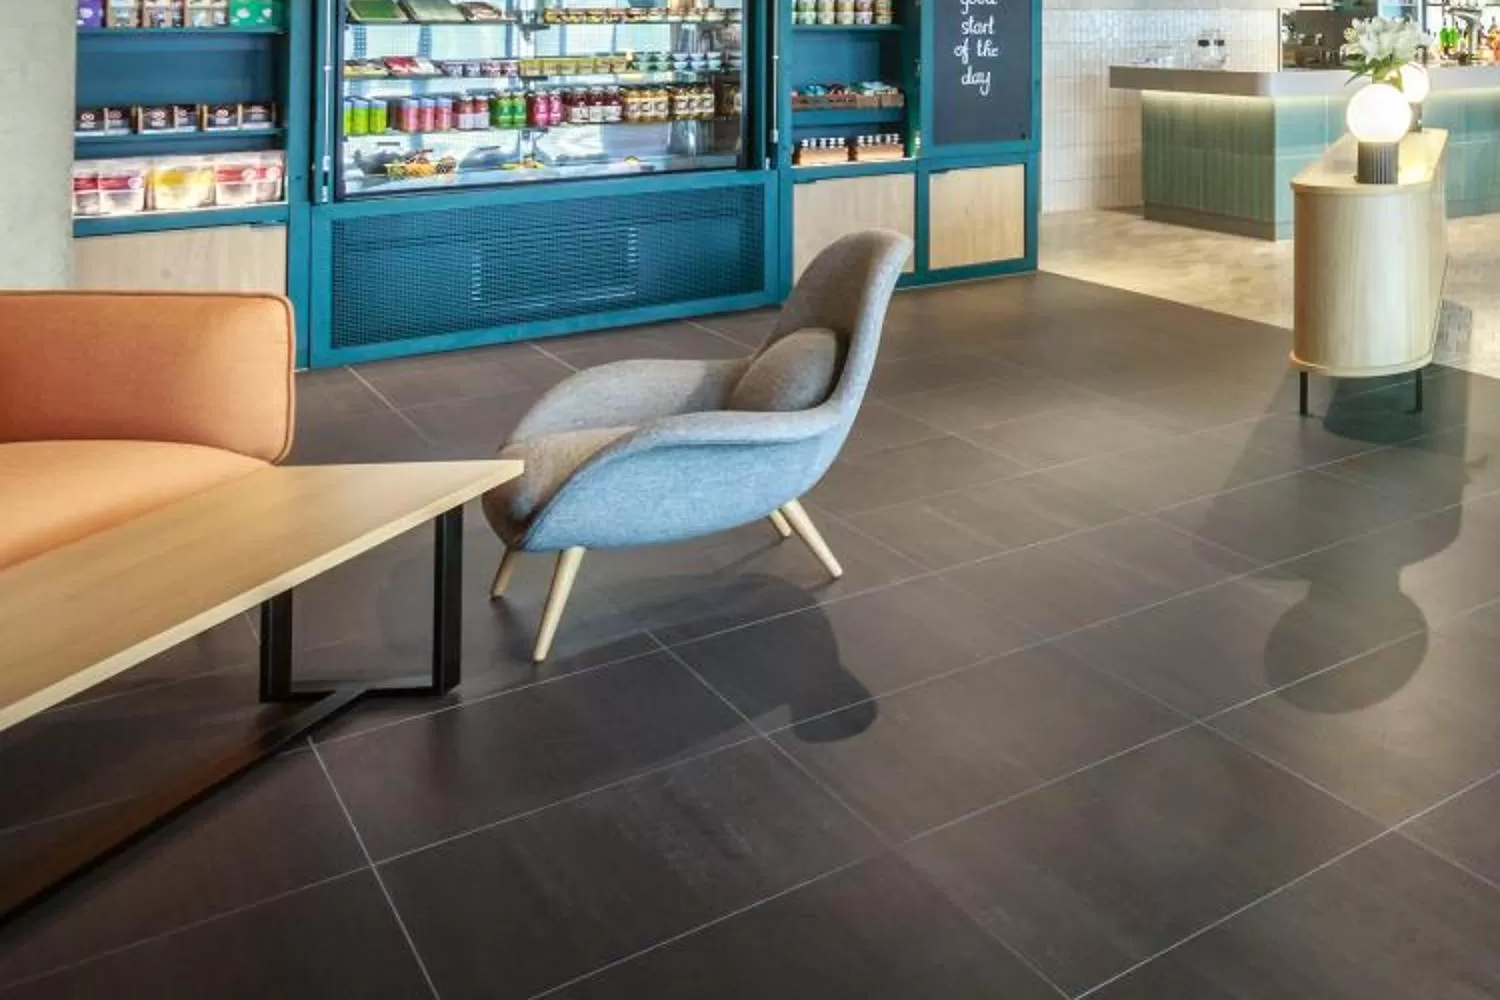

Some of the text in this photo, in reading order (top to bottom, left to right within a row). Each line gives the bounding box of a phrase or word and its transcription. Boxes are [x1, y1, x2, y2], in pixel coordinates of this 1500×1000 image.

[960, 15, 996, 36] start
[953, 36, 999, 65] of the
[960, 64, 992, 97] day
